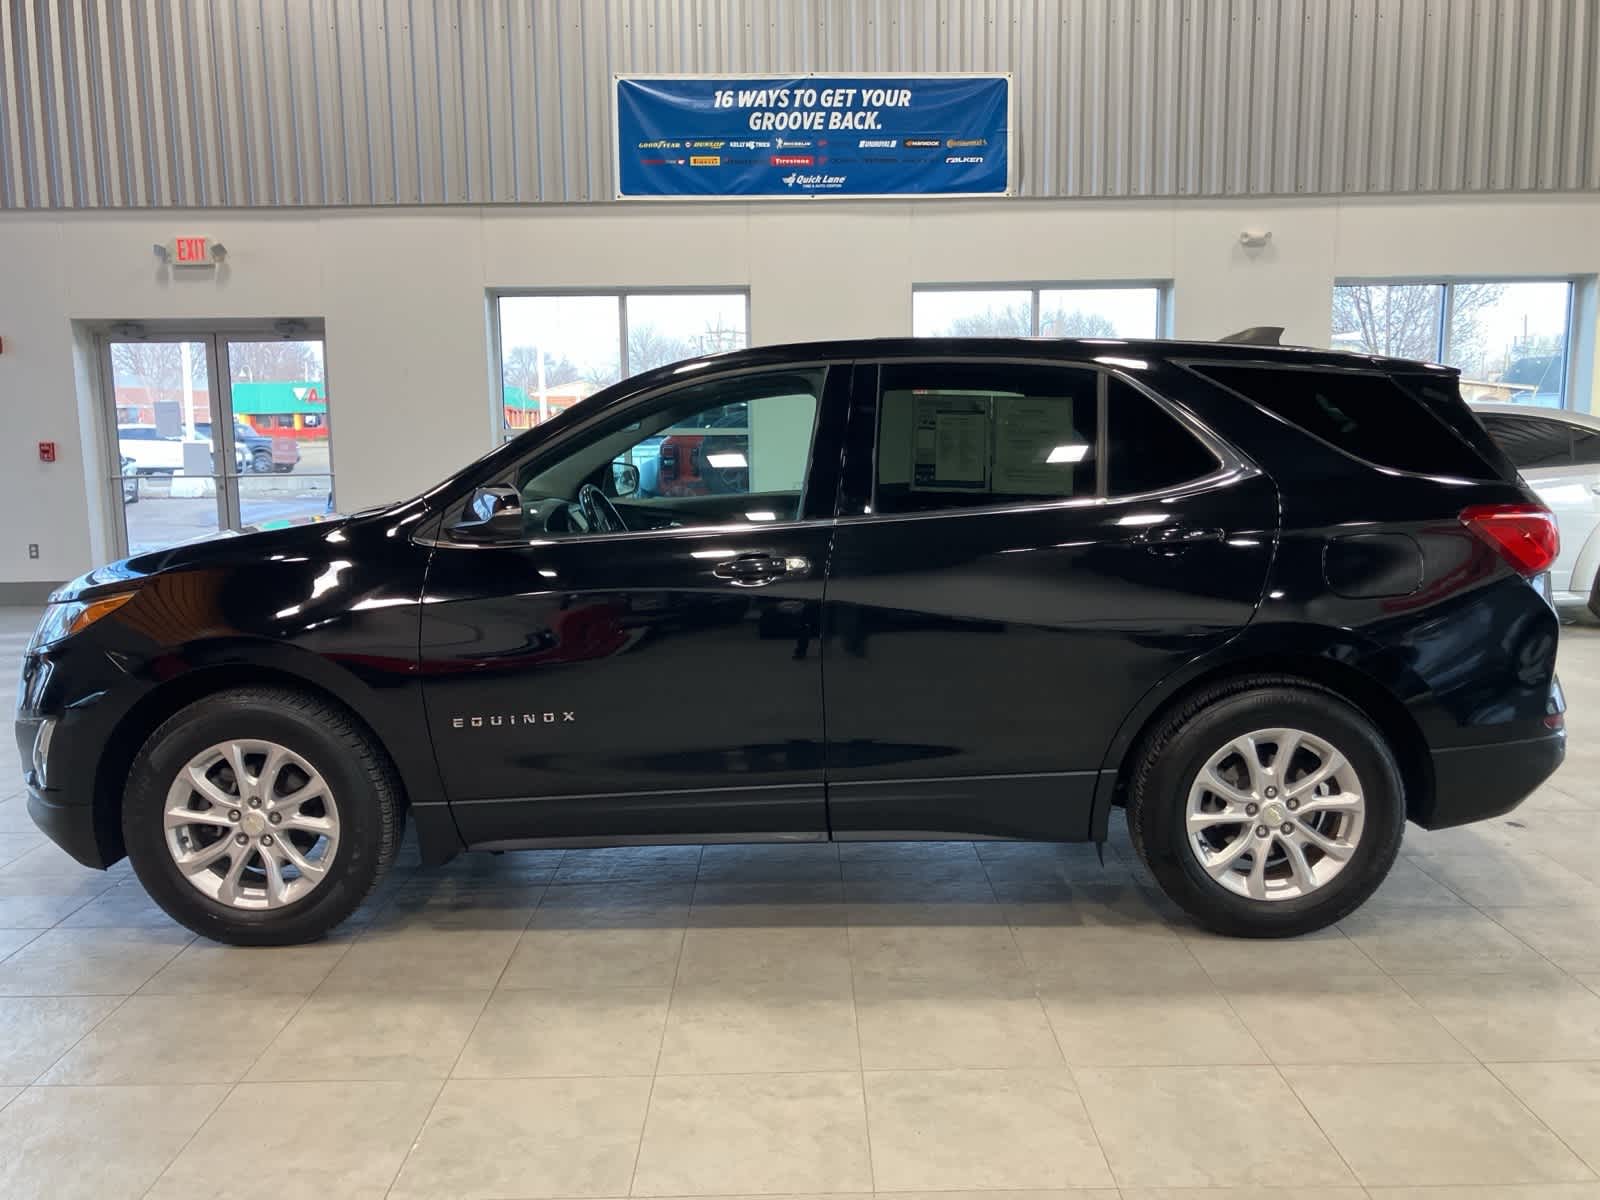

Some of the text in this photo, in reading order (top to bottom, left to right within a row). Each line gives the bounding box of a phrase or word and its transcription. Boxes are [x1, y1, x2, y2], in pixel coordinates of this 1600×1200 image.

[713, 89, 912, 108] 16 WAYS TO GET YOUR
[749, 111, 882, 130] GROOVE BACK.
[638, 140, 681, 149] GOODYEAR
[945, 156, 984, 164] FALKEN
[796, 175, 846, 184] Quick Lane
[176, 237, 206, 261] EXIT
[452, 711, 575, 728] EQUINOX
